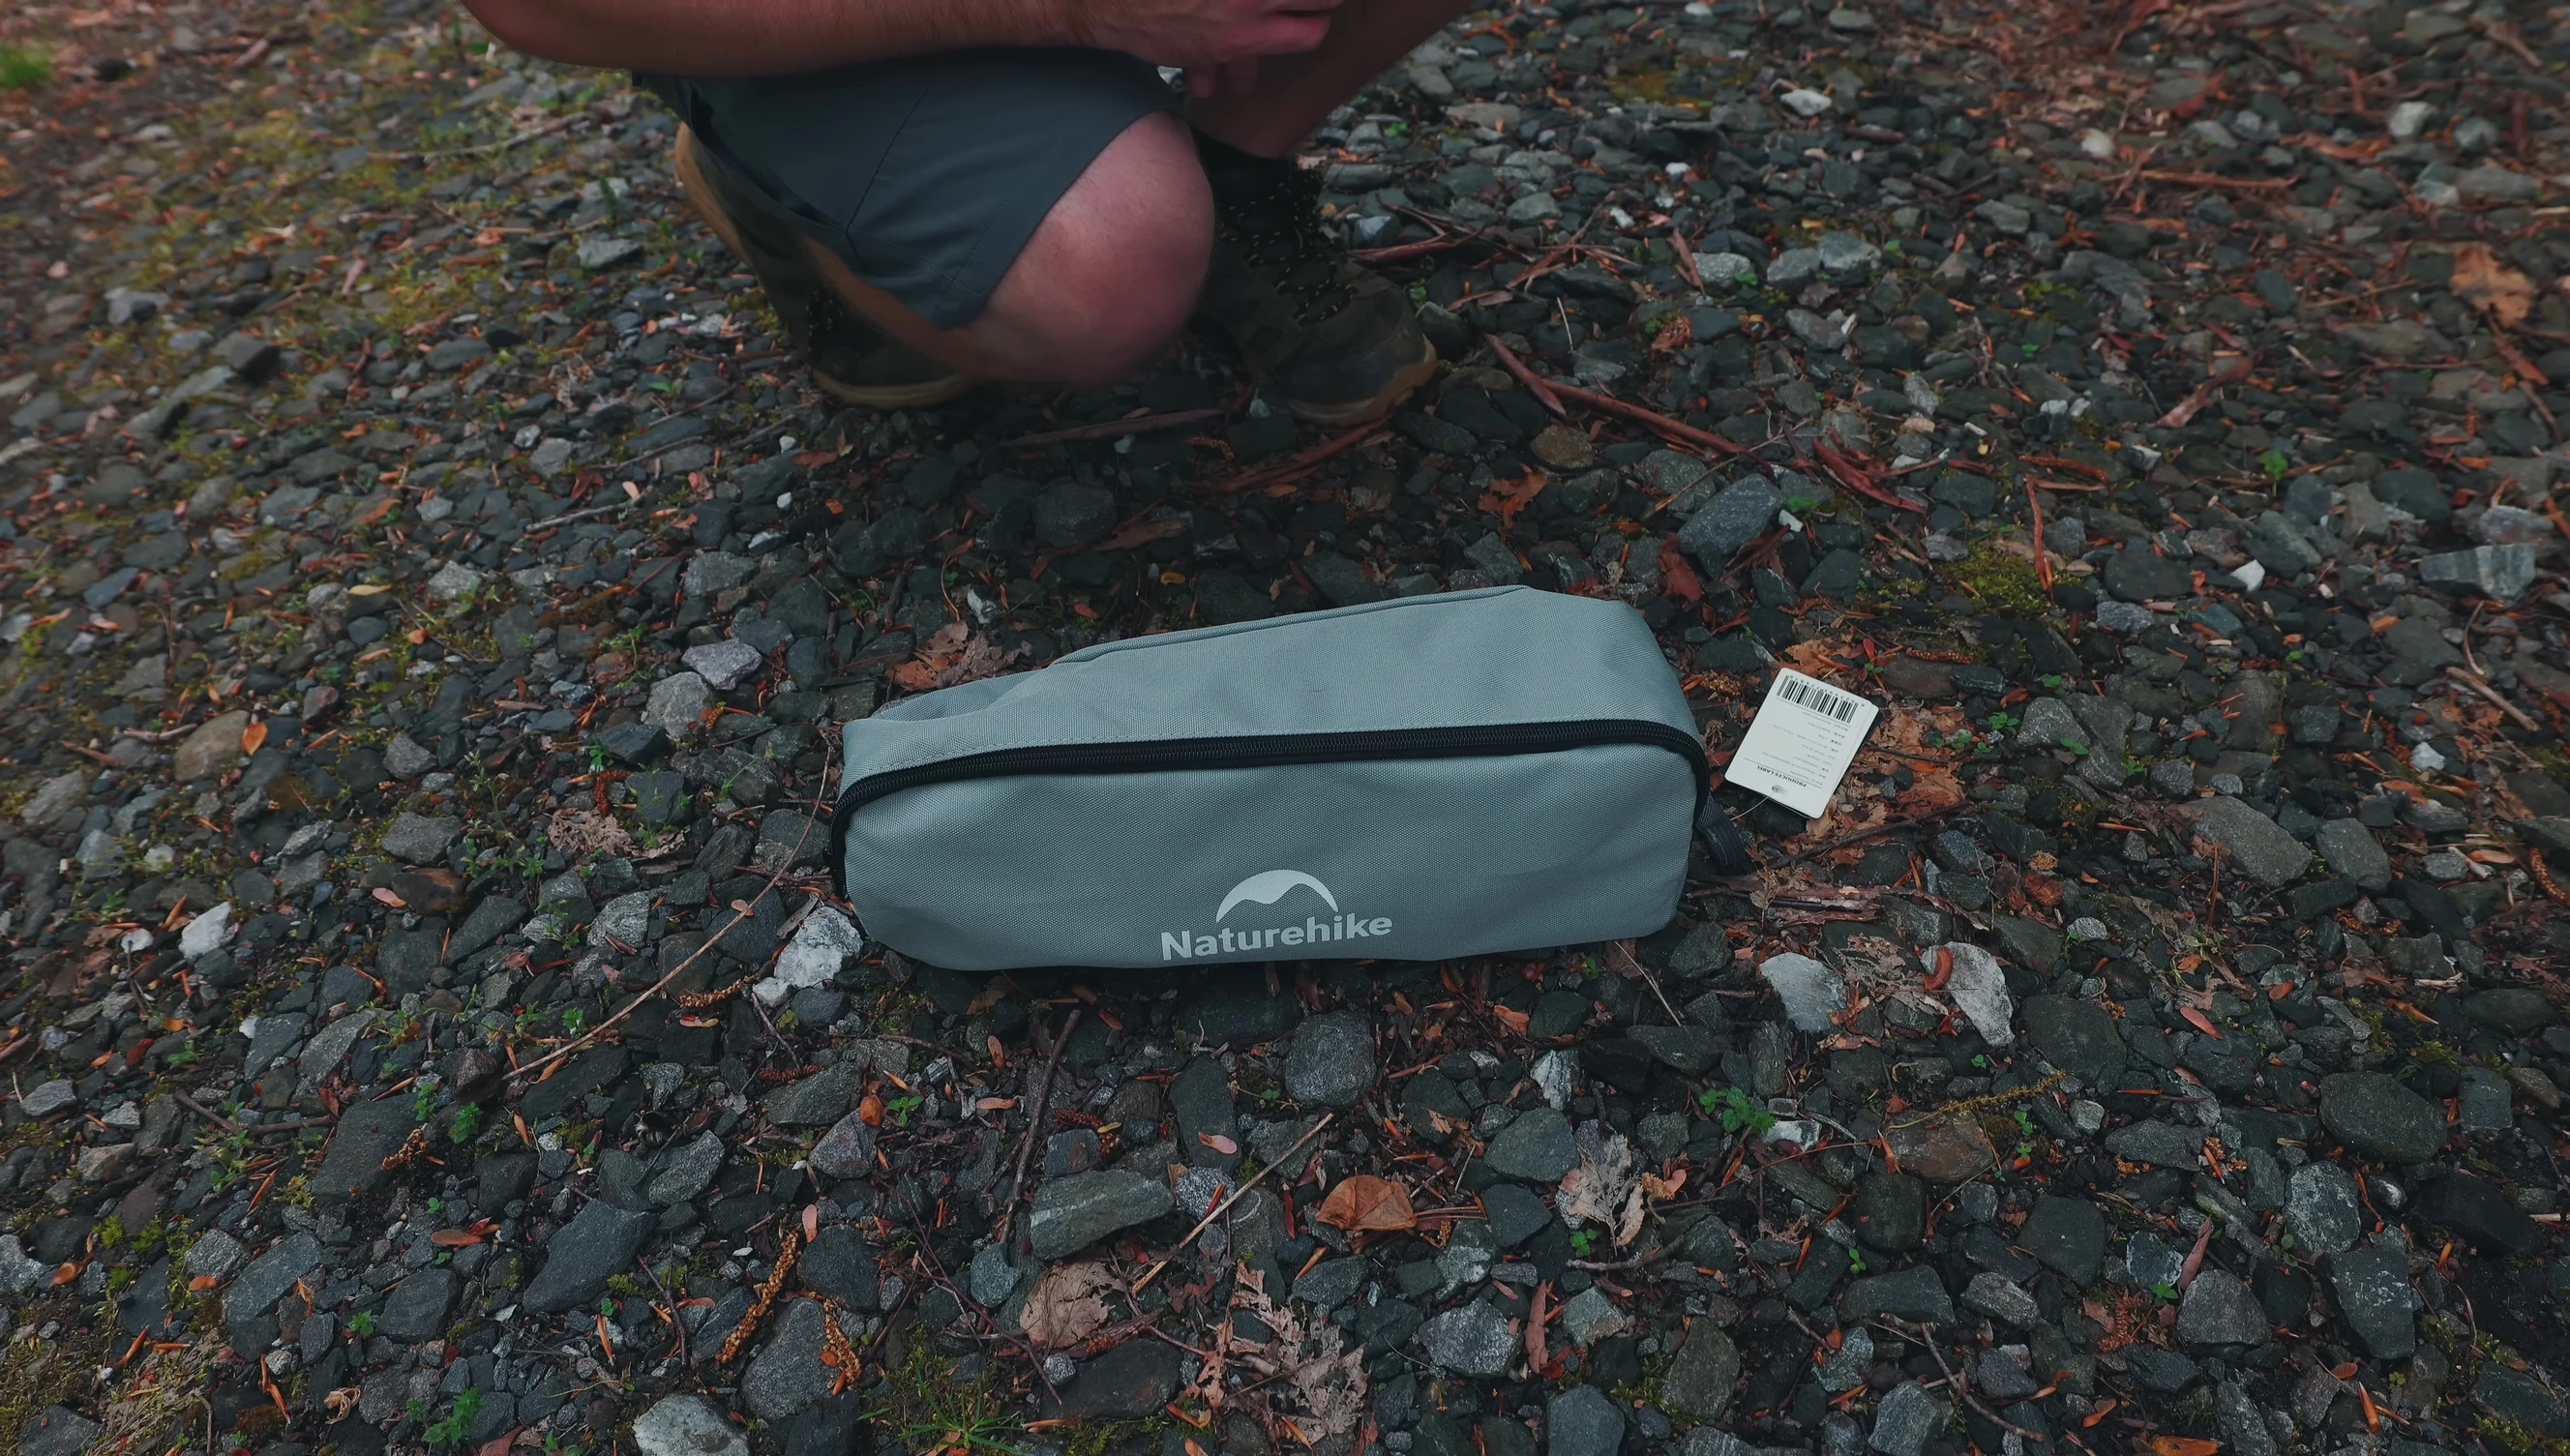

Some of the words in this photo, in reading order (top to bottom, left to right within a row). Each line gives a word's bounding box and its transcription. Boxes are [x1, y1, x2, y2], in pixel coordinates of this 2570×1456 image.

[1756, 764, 1775, 775] LABEL
[1775, 772, 1807, 787] PRODUCTS
[1161, 913, 1392, 961] Naturehike
